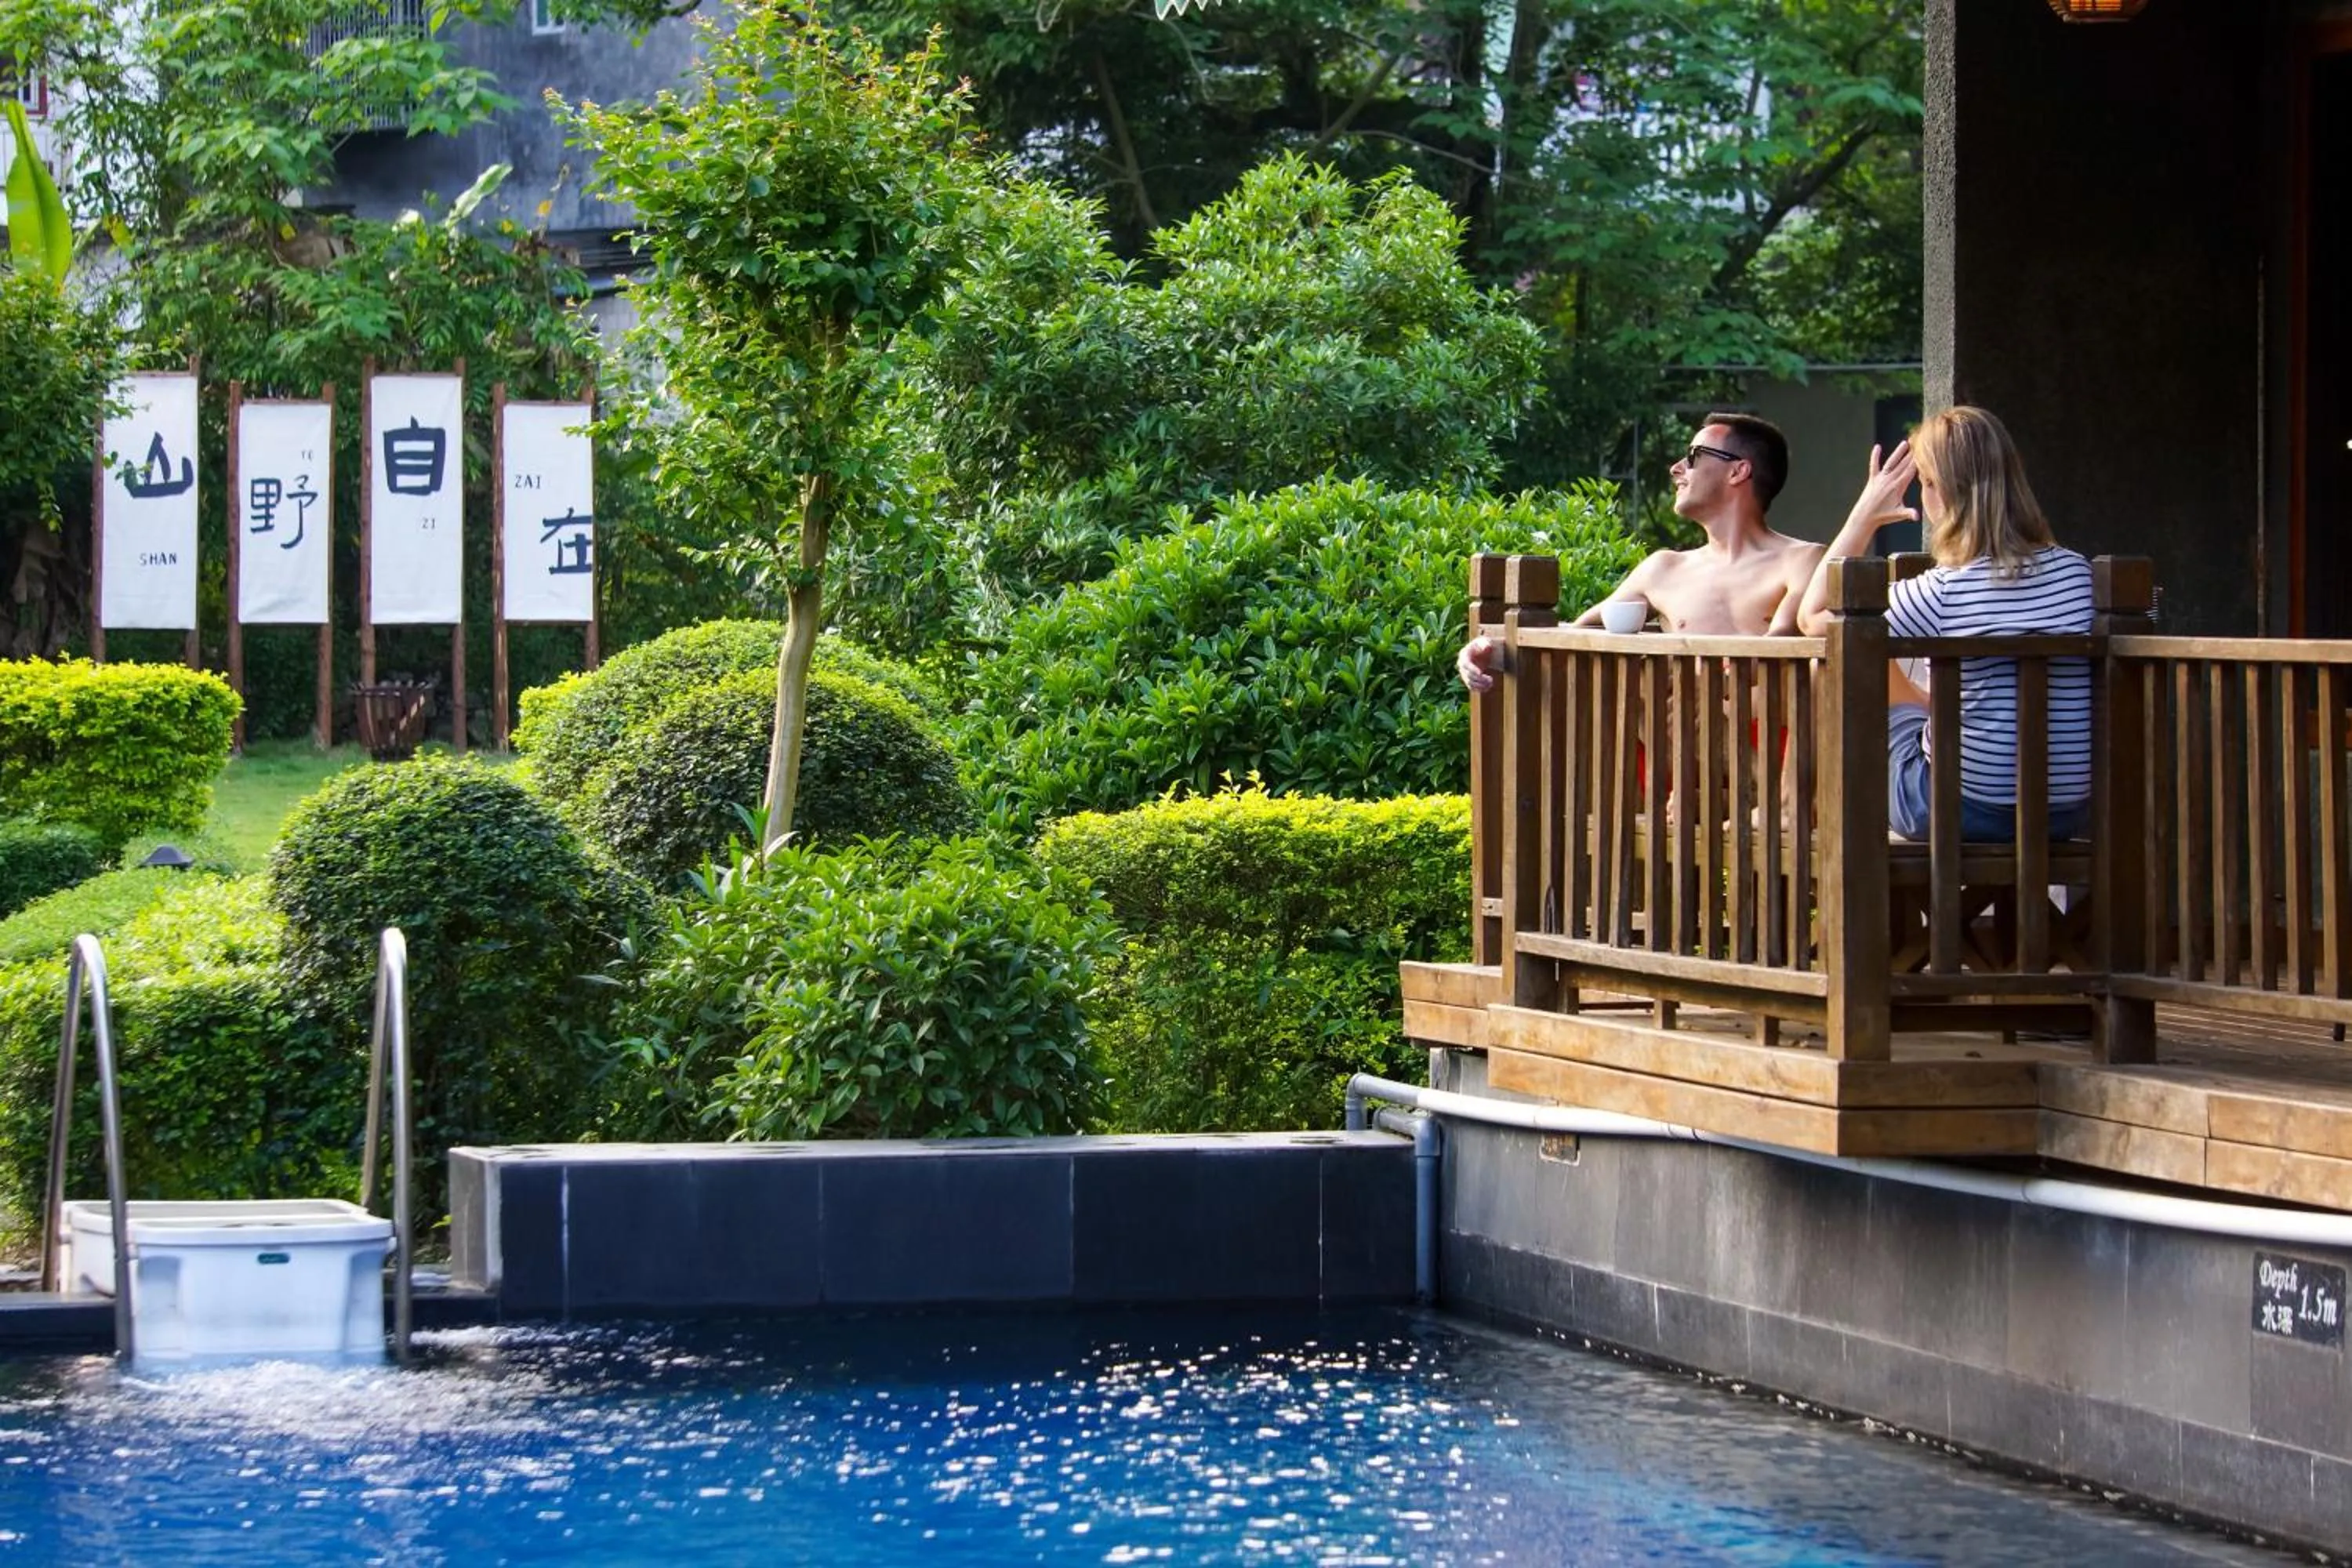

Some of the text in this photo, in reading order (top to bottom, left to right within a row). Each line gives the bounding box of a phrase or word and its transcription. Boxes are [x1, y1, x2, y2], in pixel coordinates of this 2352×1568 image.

[124, 431, 194, 498] 山
[383, 415, 446, 495] 自
[515, 474, 541, 489] ZAI
[250, 474, 318, 550] 野
[139, 551, 177, 566] SHAN
[539, 506, 593, 575] 在
[2259, 1260, 2298, 1299] Depth
[2299, 1283, 2337, 1327] 1.5m
